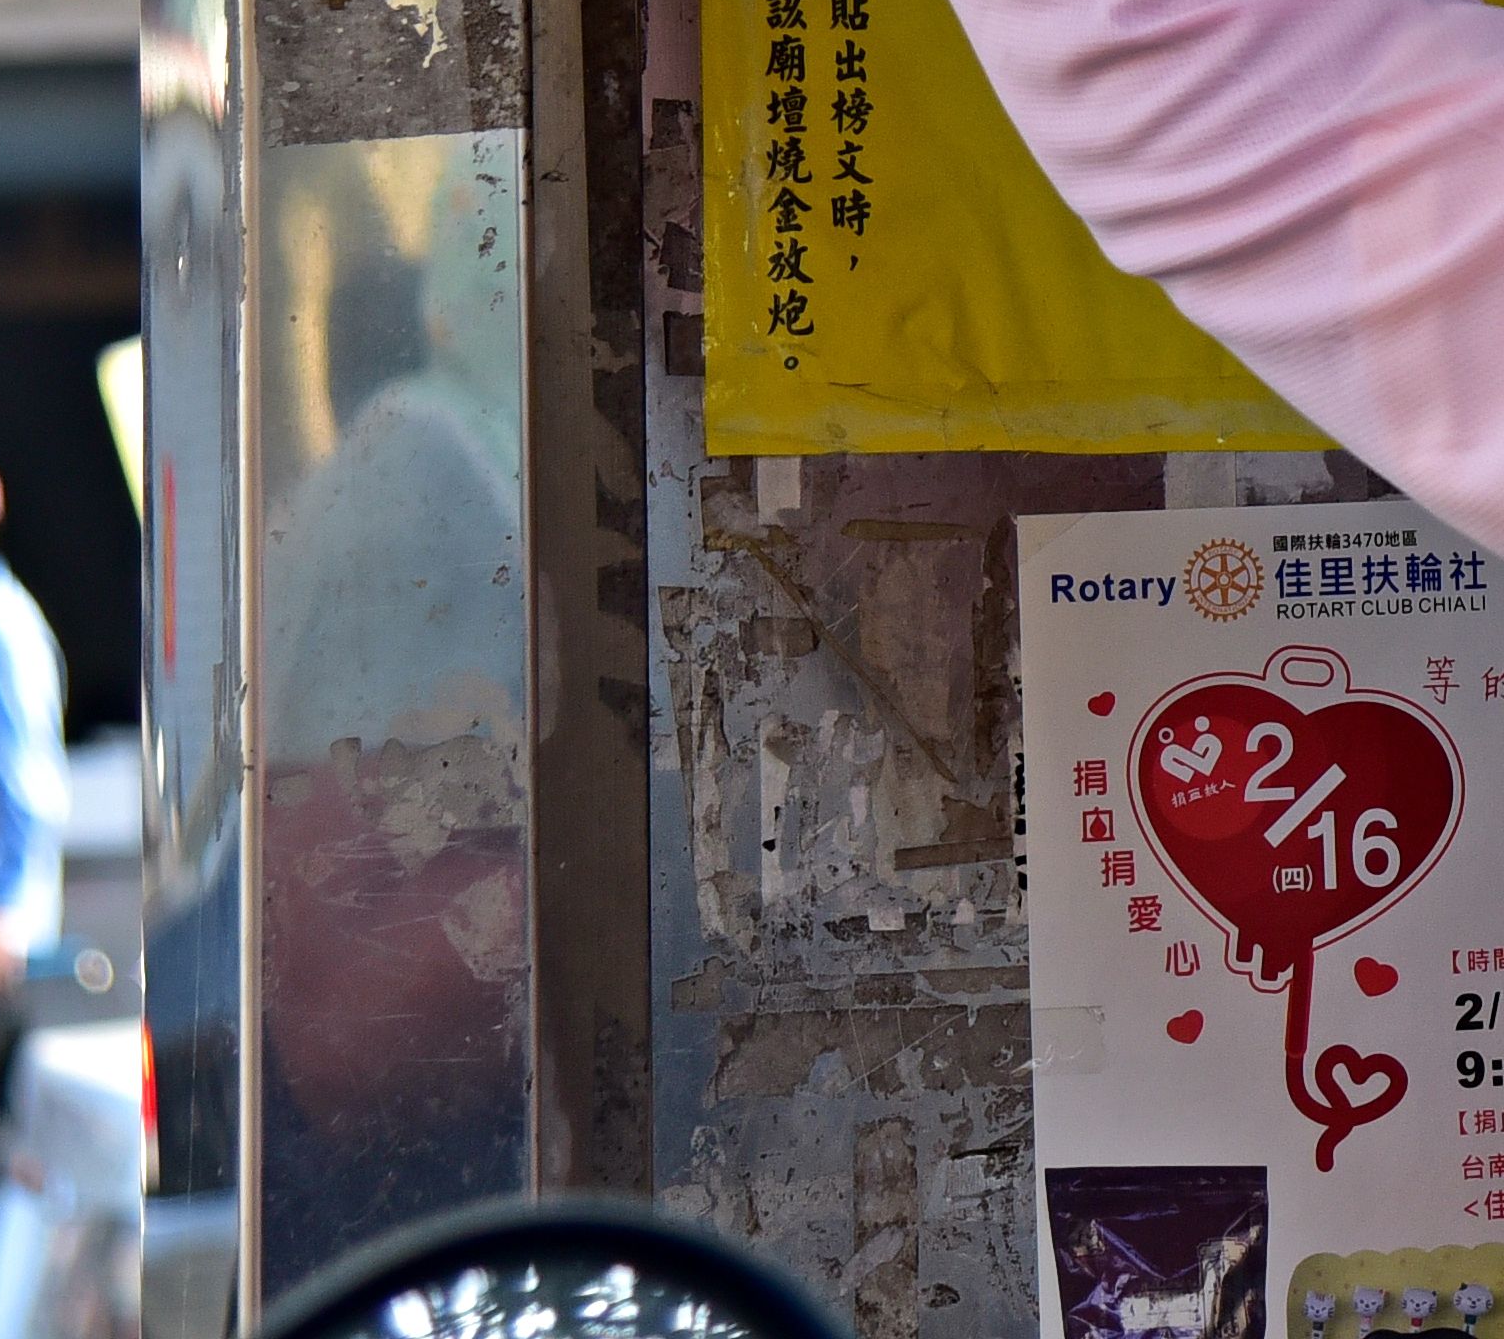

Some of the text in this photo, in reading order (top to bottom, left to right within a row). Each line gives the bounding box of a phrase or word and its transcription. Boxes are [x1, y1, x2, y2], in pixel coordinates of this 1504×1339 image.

[1272, 529, 1419, 553] 國際扶輪3470地區
[1050, 572, 1177, 608] Rotary
[1274, 550, 1488, 600] 佳里扶輪社
[1276, 600, 1357, 620] ROTART
[1361, 597, 1414, 617] CLUB
[1418, 595, 1467, 614] CHIA
[1243, 721, 1402, 891] 2/16
[1272, 863, 1314, 894] (四)
